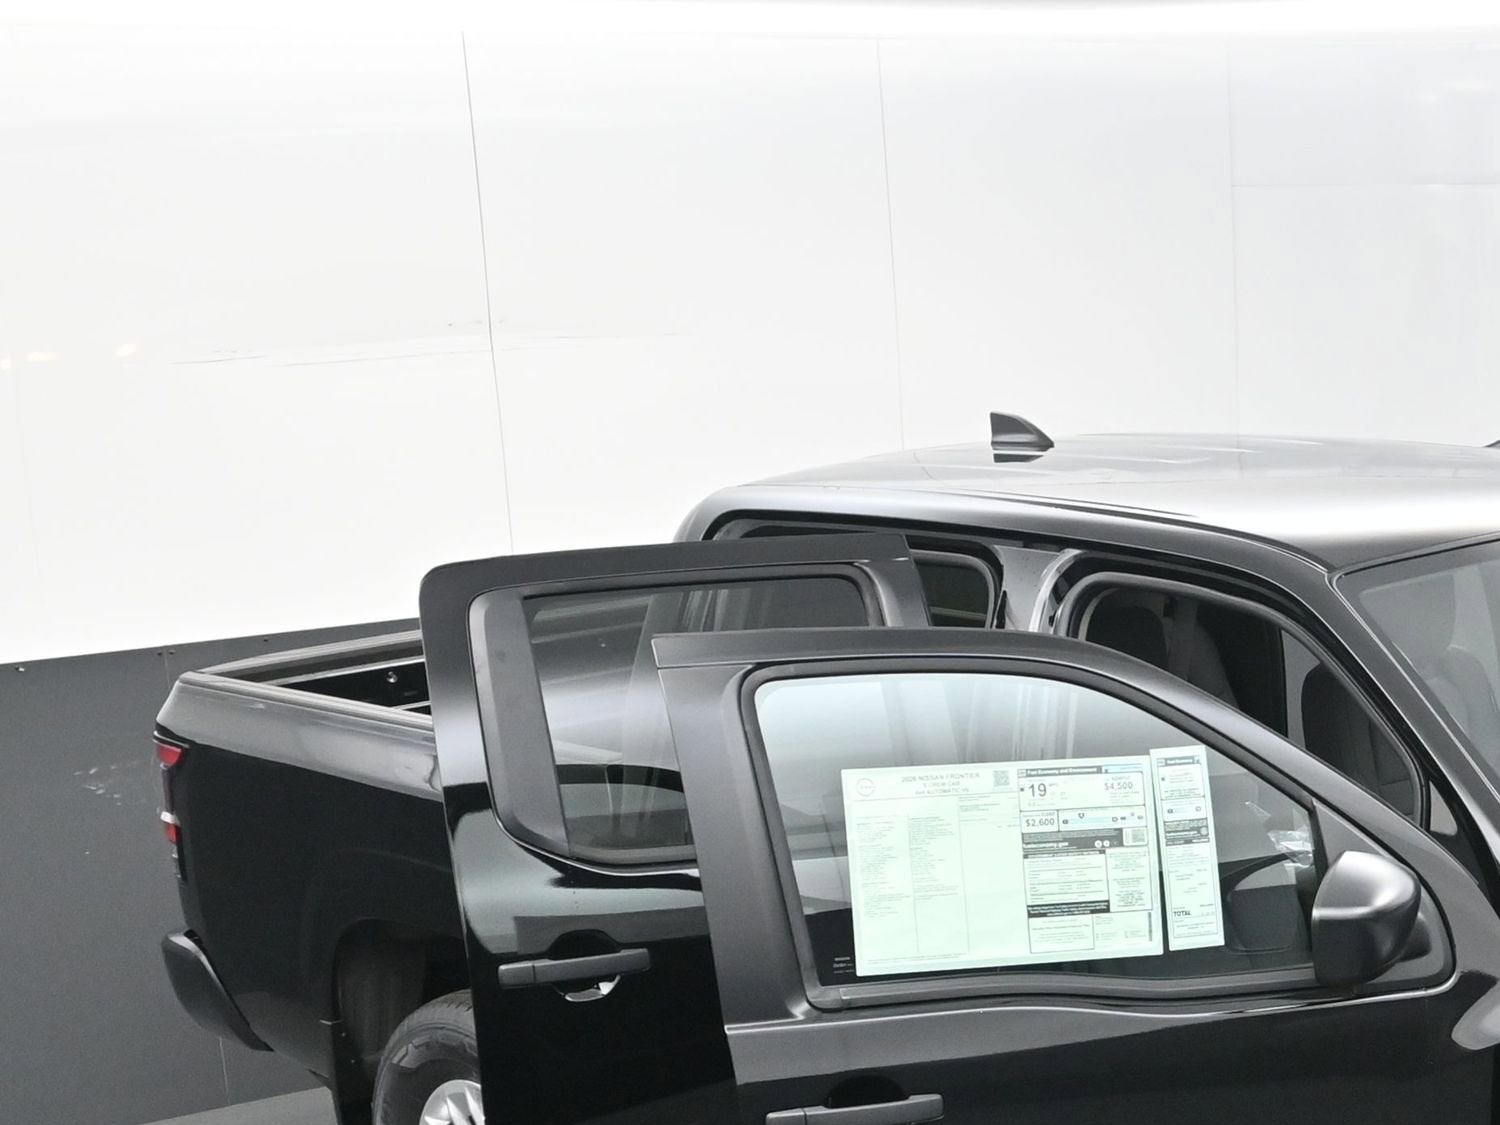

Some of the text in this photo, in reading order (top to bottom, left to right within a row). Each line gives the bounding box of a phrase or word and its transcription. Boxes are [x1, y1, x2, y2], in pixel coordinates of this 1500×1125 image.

[1028, 782, 1047, 798] 19
[1103, 780, 1134, 791] $4,500
[1025, 817, 1056, 828] $2,600
[1172, 909, 1192, 918] TOTAL
